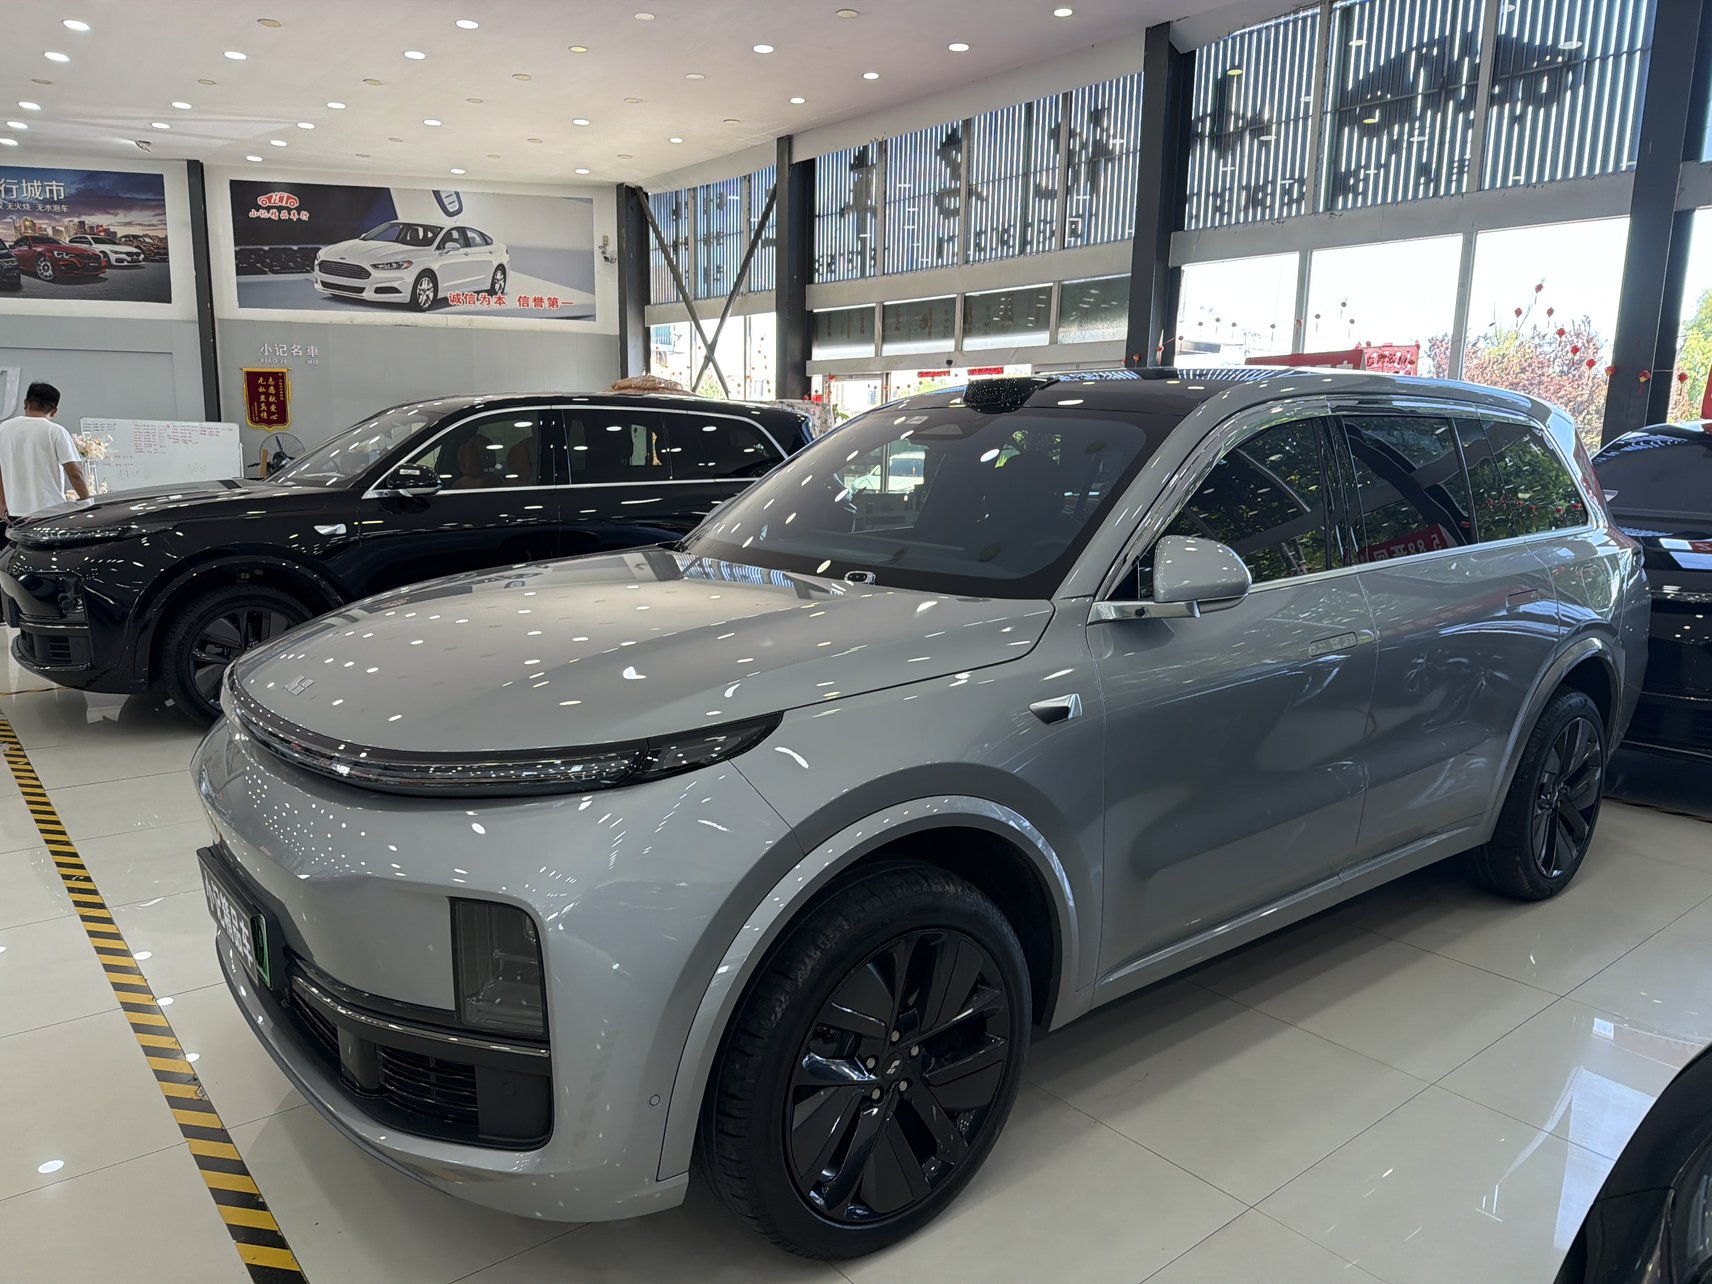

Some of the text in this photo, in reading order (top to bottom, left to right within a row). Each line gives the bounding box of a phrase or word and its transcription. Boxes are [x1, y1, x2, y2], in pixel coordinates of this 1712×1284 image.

[0, 178, 66, 201] 行城市
[248, 208, 310, 221] 小记精品车行
[448, 292, 576, 309] 诚信为本 信誉第一
[260, 343, 320, 357] 小记名車
